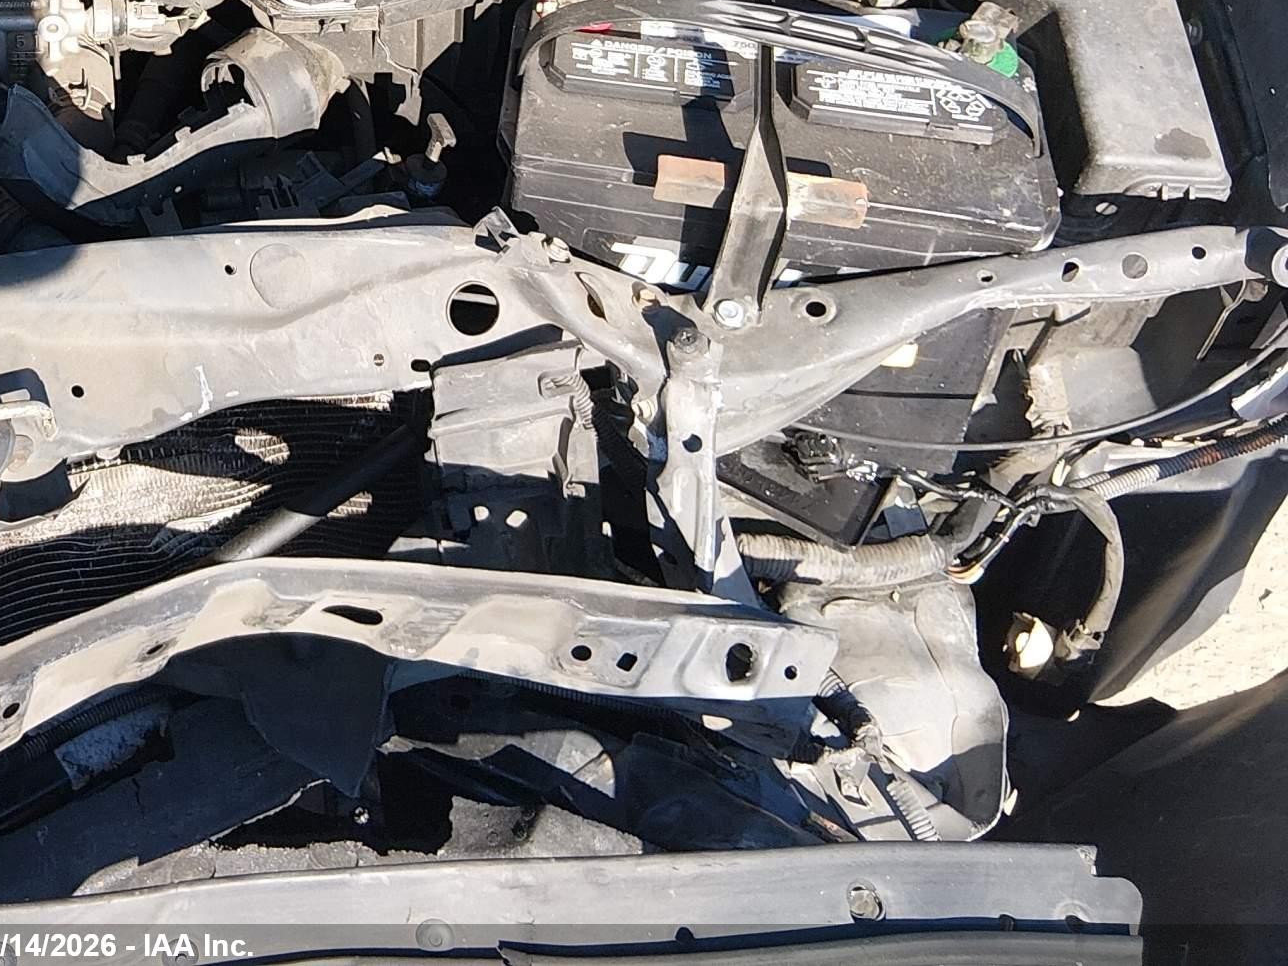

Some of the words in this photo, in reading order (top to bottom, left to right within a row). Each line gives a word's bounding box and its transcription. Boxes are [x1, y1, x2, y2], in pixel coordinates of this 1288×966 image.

[15, 33, 26, 49] 5
[603, 40, 655, 54] DANGER
[666, 47, 712, 60] POISON
